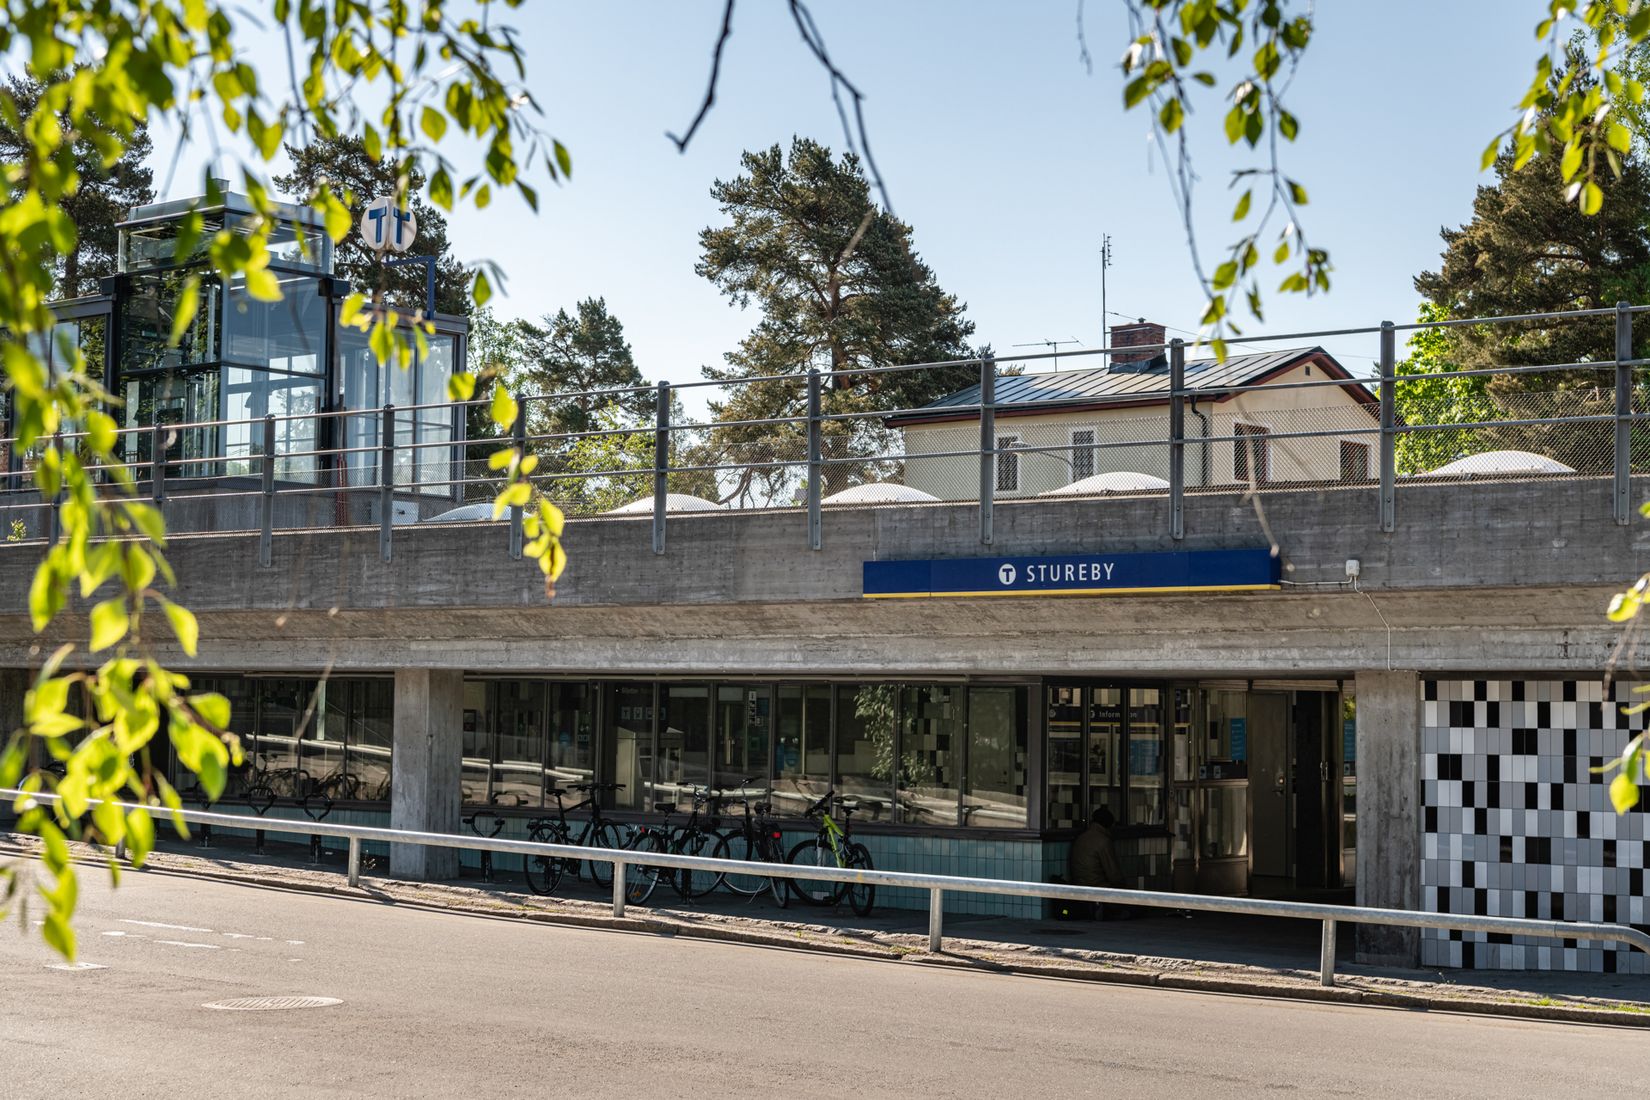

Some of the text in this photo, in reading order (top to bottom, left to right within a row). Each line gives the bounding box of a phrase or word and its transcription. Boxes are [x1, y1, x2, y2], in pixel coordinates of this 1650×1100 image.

[369, 206, 387, 243] T
[393, 207, 411, 245] T
[1001, 563, 1114, 583] T STUREBY
